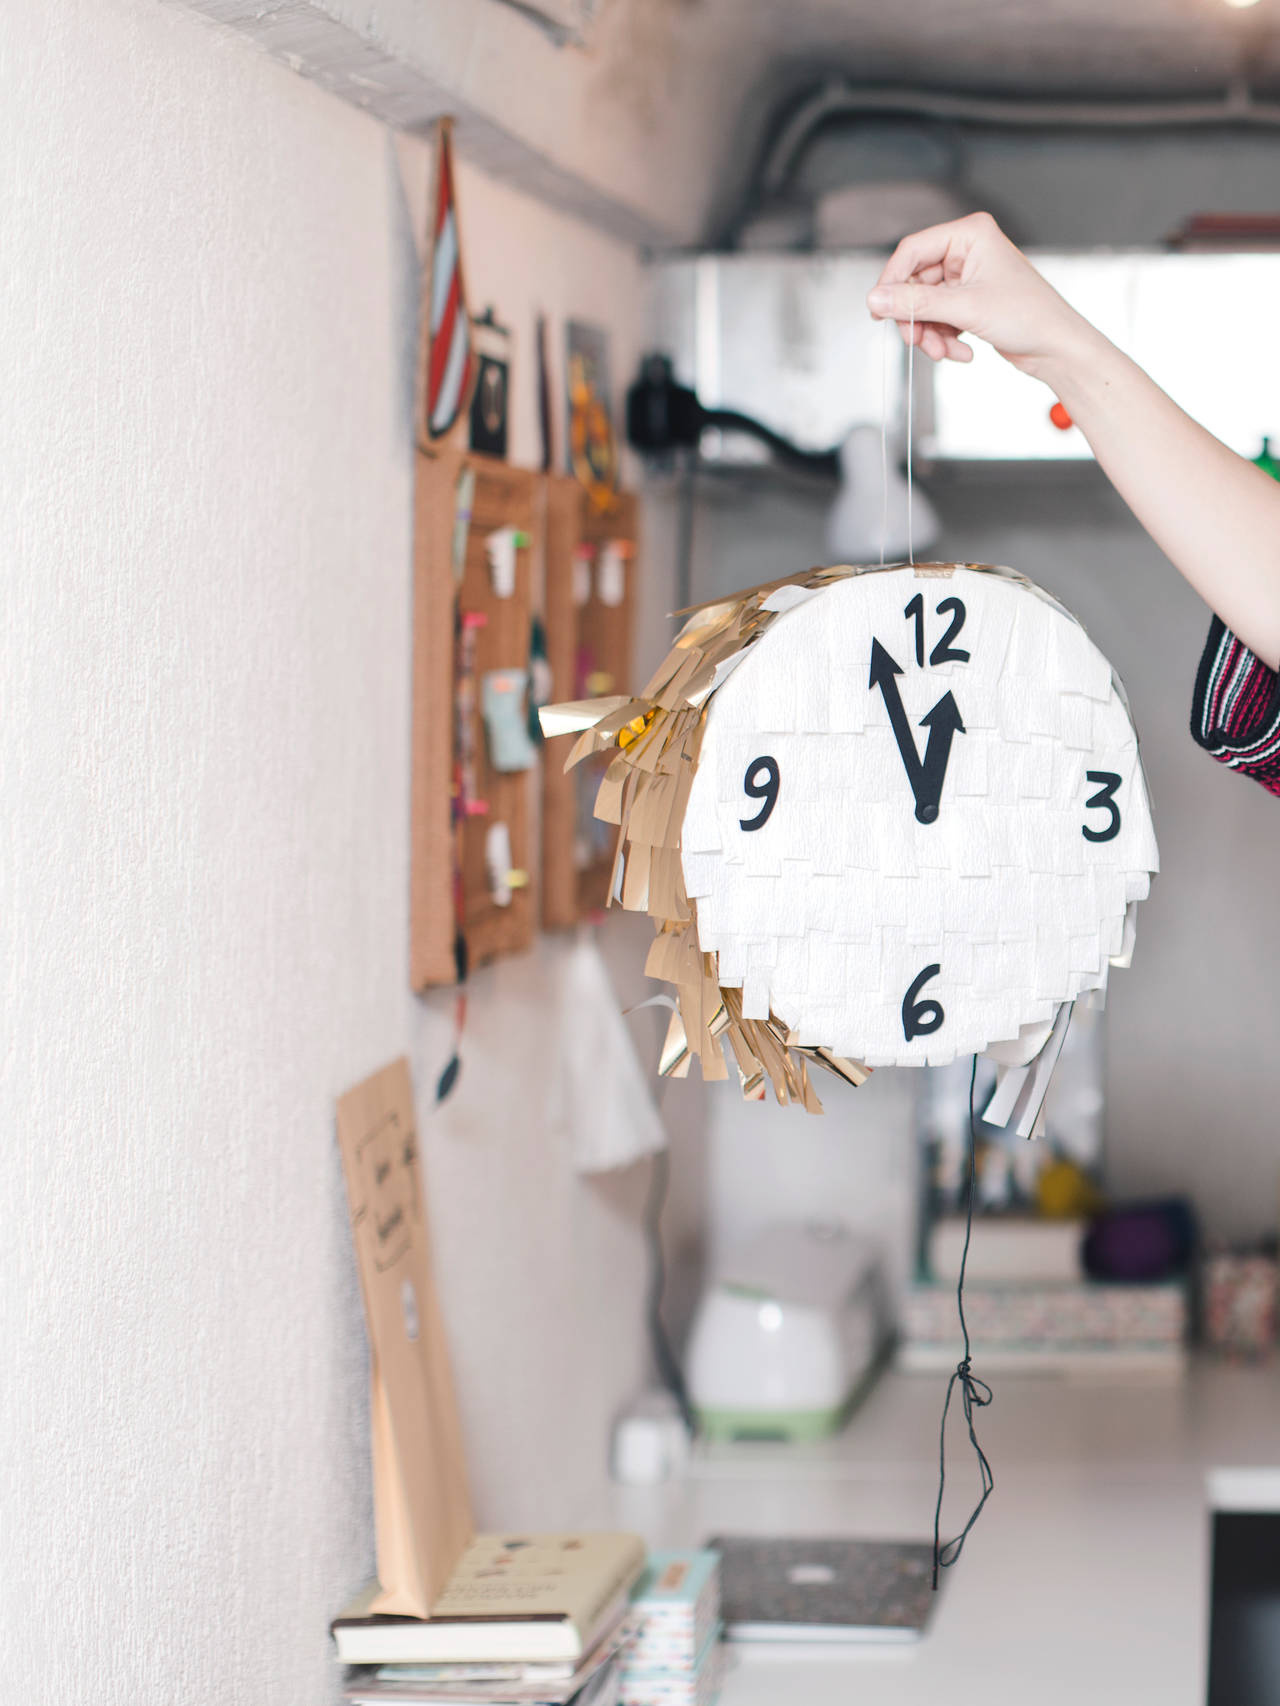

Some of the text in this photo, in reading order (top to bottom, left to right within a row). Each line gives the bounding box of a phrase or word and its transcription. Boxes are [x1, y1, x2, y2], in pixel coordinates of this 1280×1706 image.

[904, 593, 971, 668] 12
[740, 756, 780, 831] 9
[1082, 771, 1122, 842] 3
[902, 964, 944, 1042] 6
